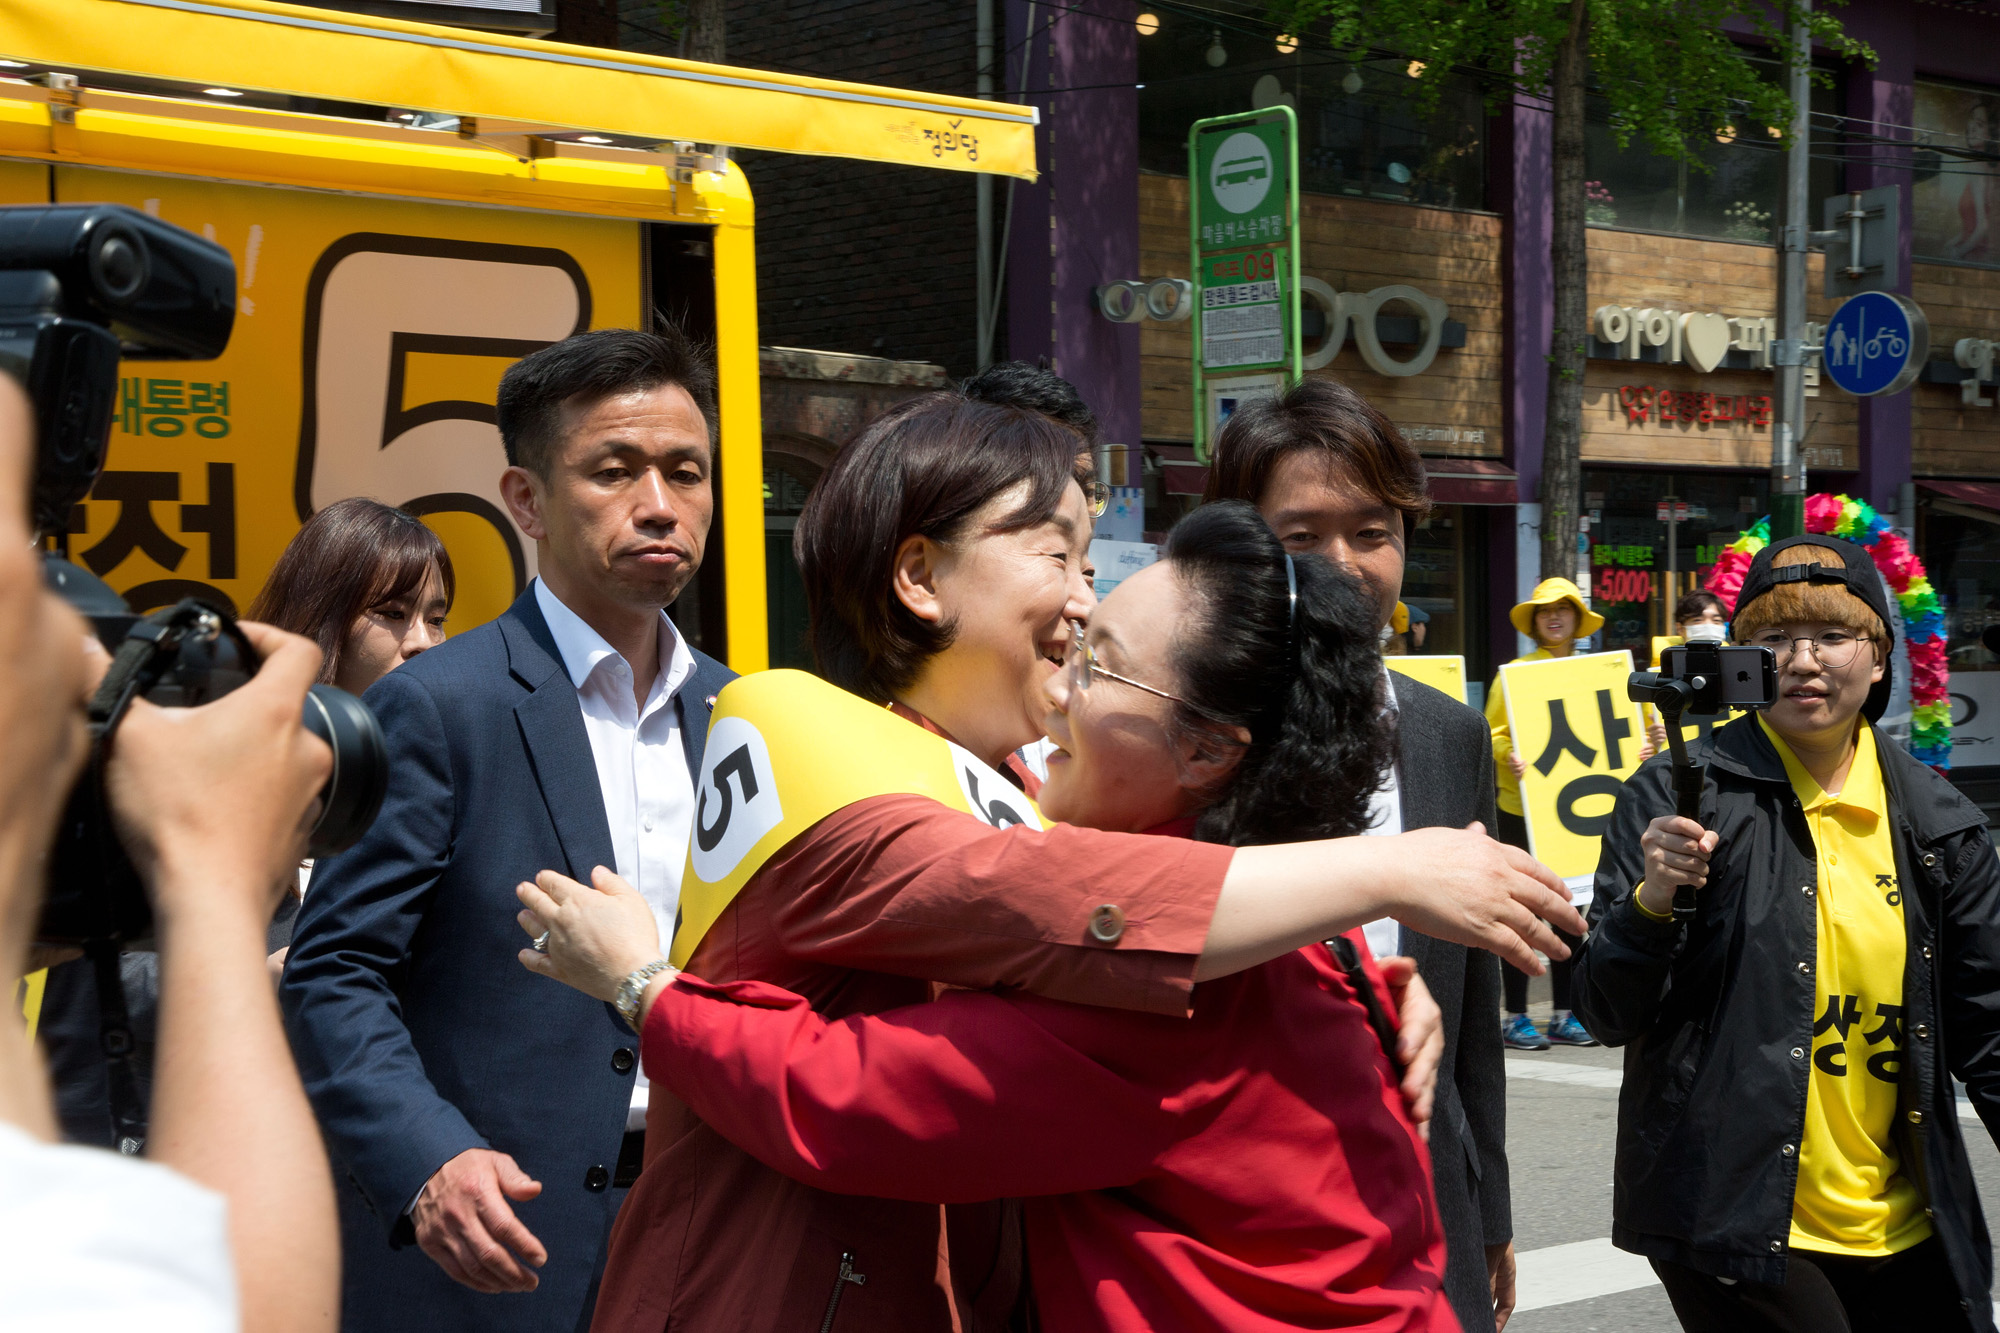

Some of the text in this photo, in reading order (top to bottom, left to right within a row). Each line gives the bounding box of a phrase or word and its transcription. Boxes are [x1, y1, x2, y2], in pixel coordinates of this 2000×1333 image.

[922, 125, 979, 162] 정의당
[1202, 215, 1282, 245] 마을버스승차장
[697, 743, 759, 853] 5
[1533, 689, 1631, 837] 상
